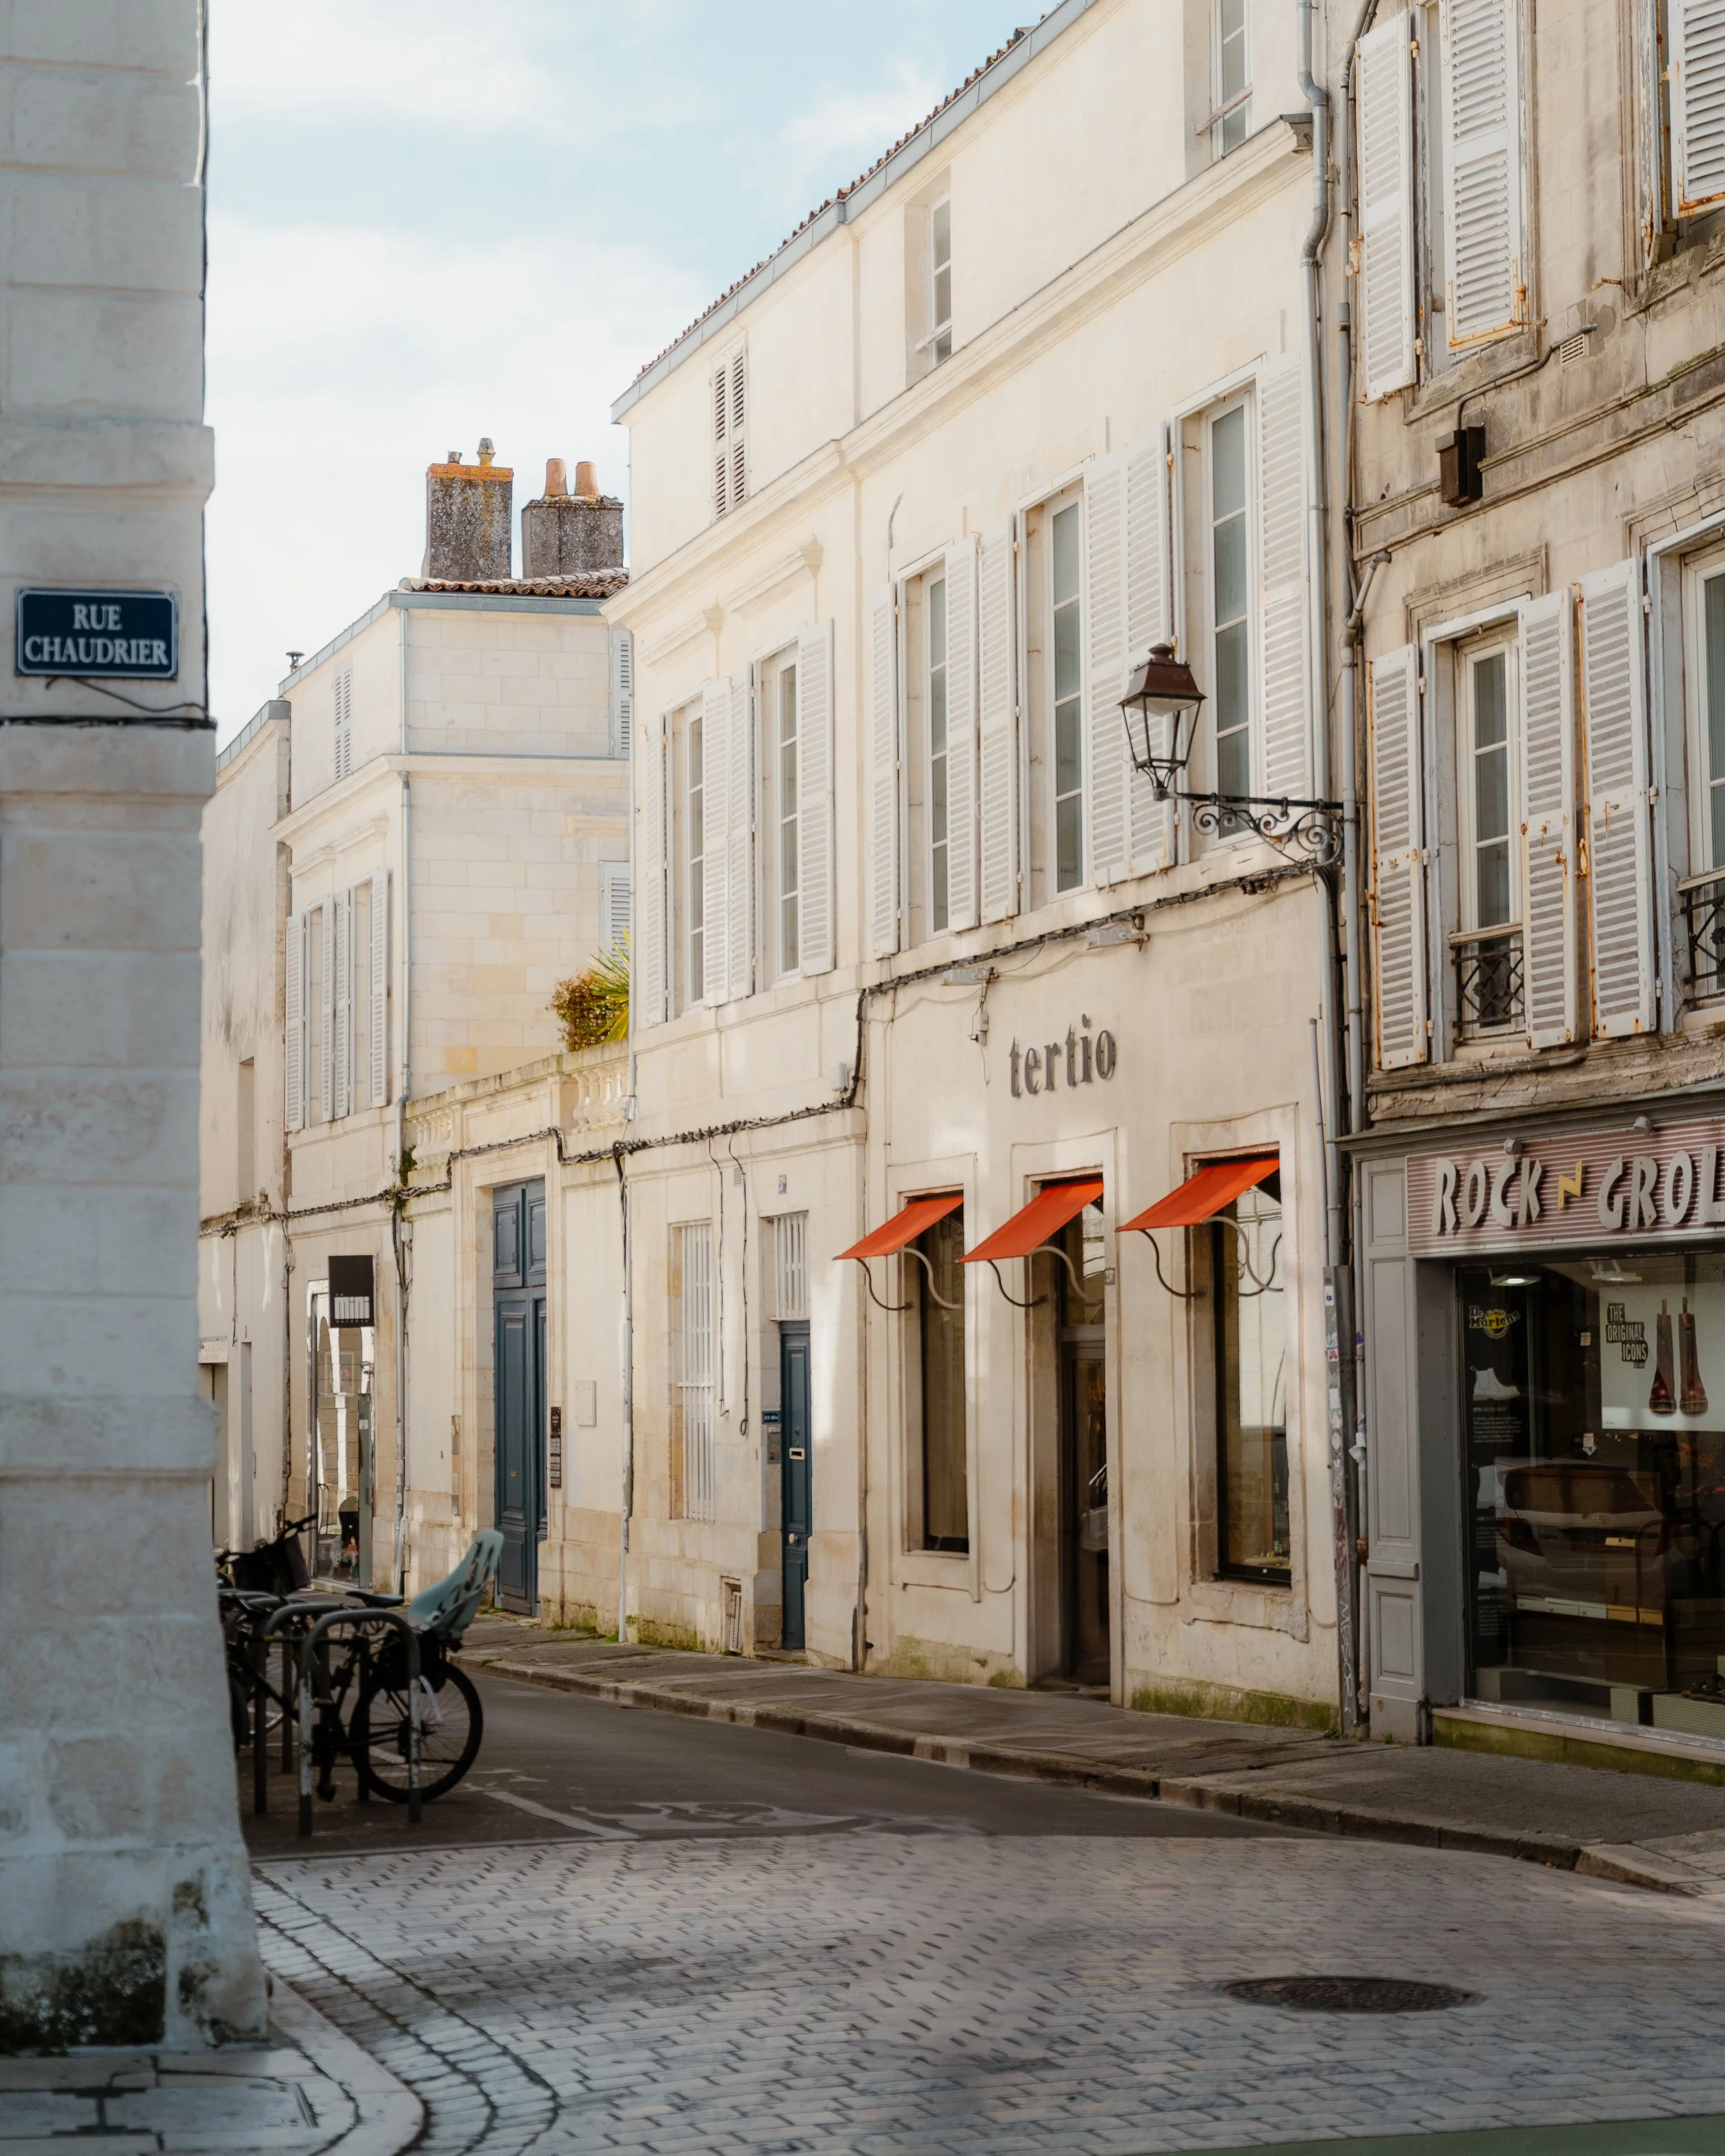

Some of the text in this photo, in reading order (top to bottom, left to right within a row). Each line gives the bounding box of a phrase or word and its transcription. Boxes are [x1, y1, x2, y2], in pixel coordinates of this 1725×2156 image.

[72, 604, 122, 631] RUE
[24, 635, 169, 665] CHAUDRIER
[1009, 1013, 1116, 1098] tertio
[1431, 1145, 1725, 1234] ROCK N GROL
[1469, 1310, 1521, 1329] Martens
[1608, 1305, 1624, 1322] THE
[1607, 1324, 1644, 1342] ORIGINAL
[1622, 1343, 1647, 1361] ICONS
